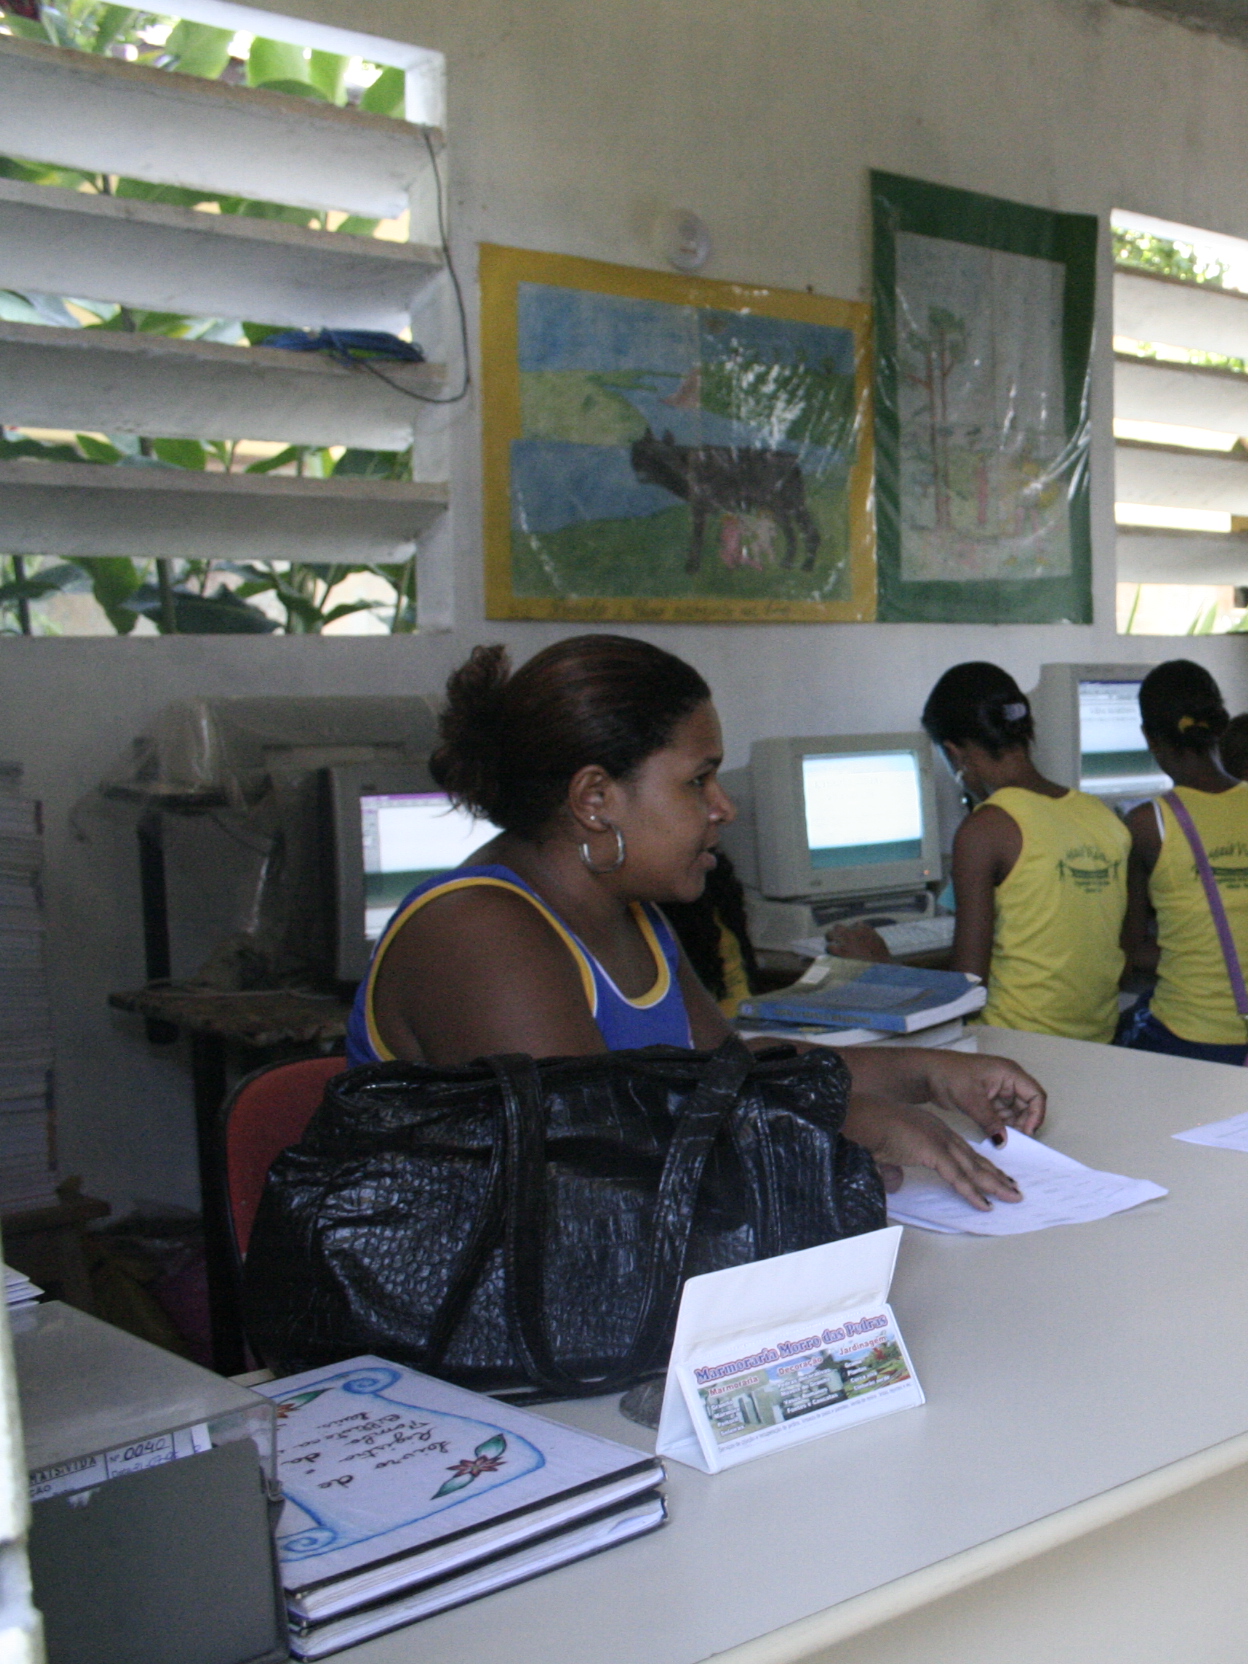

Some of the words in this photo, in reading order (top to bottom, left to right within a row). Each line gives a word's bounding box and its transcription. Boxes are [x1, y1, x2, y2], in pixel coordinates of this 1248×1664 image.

[694, 1347, 780, 1385] Marmoraria
[777, 1336, 822, 1358] Morro
[822, 1329, 845, 1345] das
[843, 1315, 888, 1337] Pedras
[839, 1336, 887, 1355] Jardinagem
[778, 1357, 823, 1376] Decoração
[709, 1376, 759, 1396] Marmoraria
